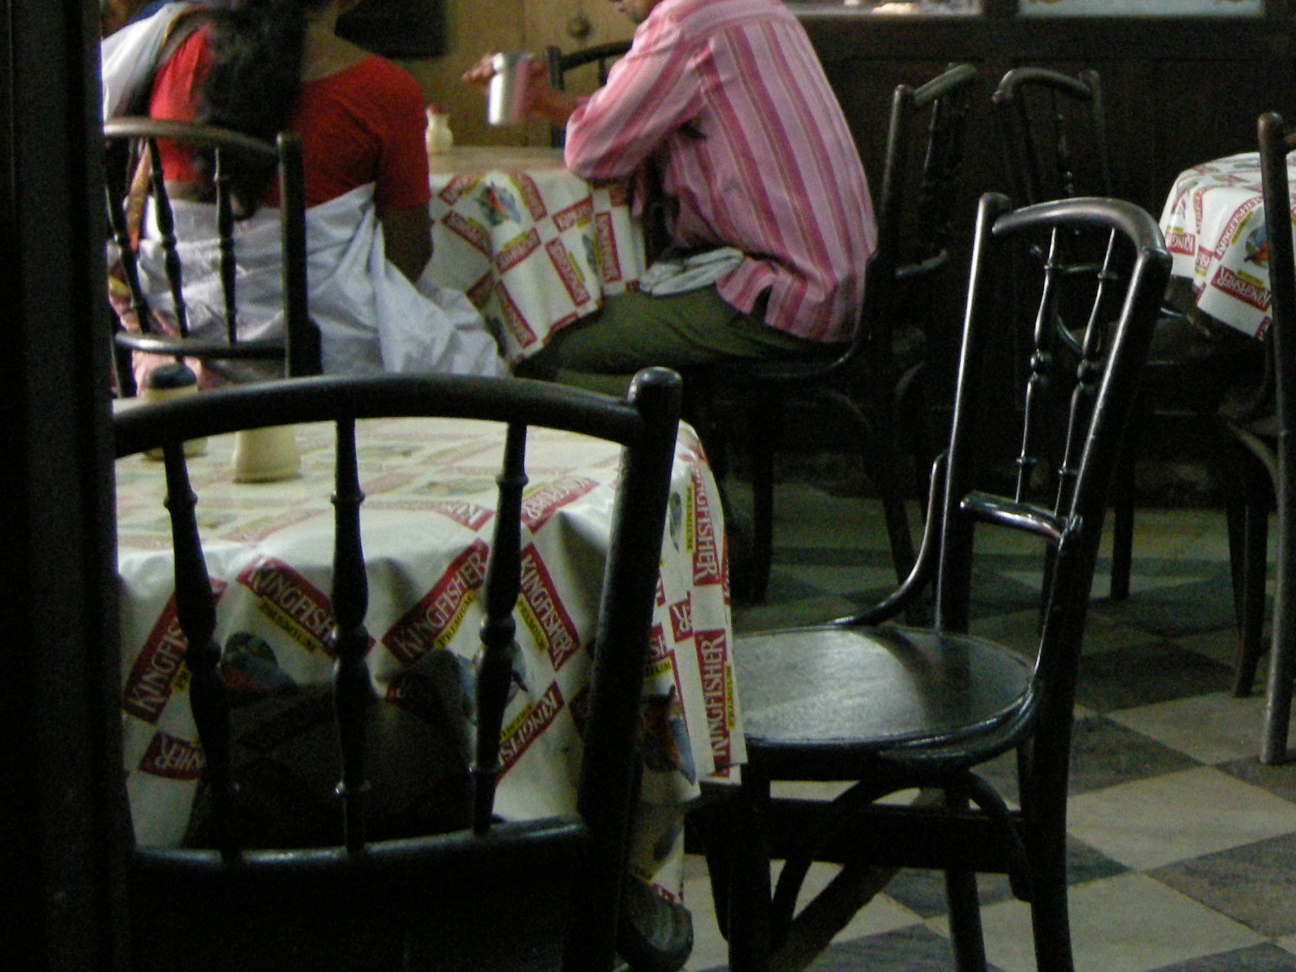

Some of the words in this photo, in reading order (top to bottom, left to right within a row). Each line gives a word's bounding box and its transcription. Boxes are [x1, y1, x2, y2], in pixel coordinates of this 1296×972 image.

[248, 566, 337, 646] KINGFISH
[391, 549, 488, 658] KINGFISHER
[125, 622, 190, 715] KINGFIS
[700, 634, 726, 760] KINGFISHER
[499, 690, 562, 763] KINGFIS
